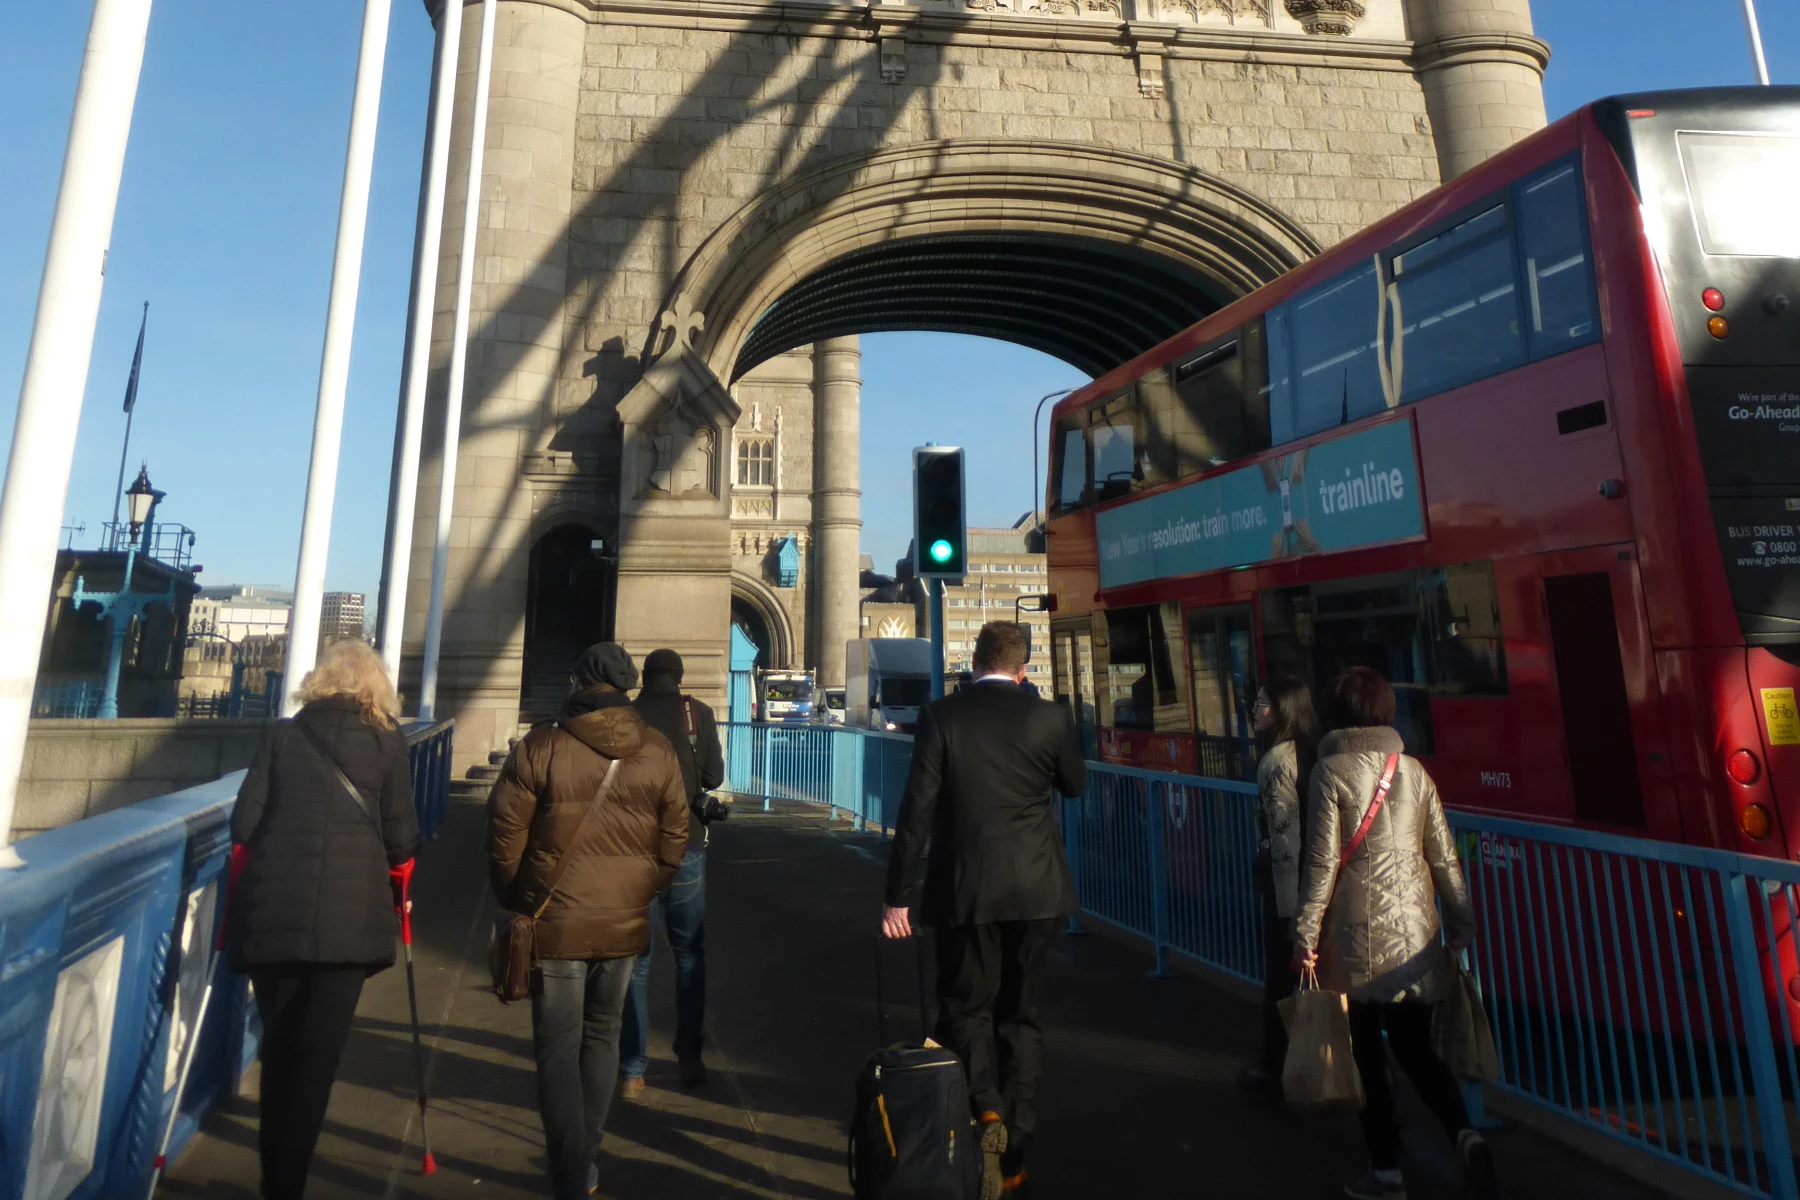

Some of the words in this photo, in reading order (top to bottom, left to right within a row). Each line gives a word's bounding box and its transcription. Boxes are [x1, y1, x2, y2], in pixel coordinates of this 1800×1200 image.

[1738, 392, 1759, 402] We're
[1761, 393, 1777, 403] part
[1778, 392, 1788, 402] of
[1788, 392, 1800, 402] the
[1728, 404, 1800, 420] Go-Ahead
[1319, 461, 1404, 515] trainline
[1101, 538, 1121, 560] New
[1121, 528, 1147, 556] Year's
[1147, 516, 1201, 550] resolution:
[1203, 507, 1230, 539] train
[1231, 504, 1268, 533] more.
[1728, 525, 1752, 538] BUS
[1752, 524, 1795, 538] DRIVER
[1769, 541, 1797, 553] 0800
[1765, 692, 1792, 700] Caution
[1480, 770, 1512, 789] MHV73
